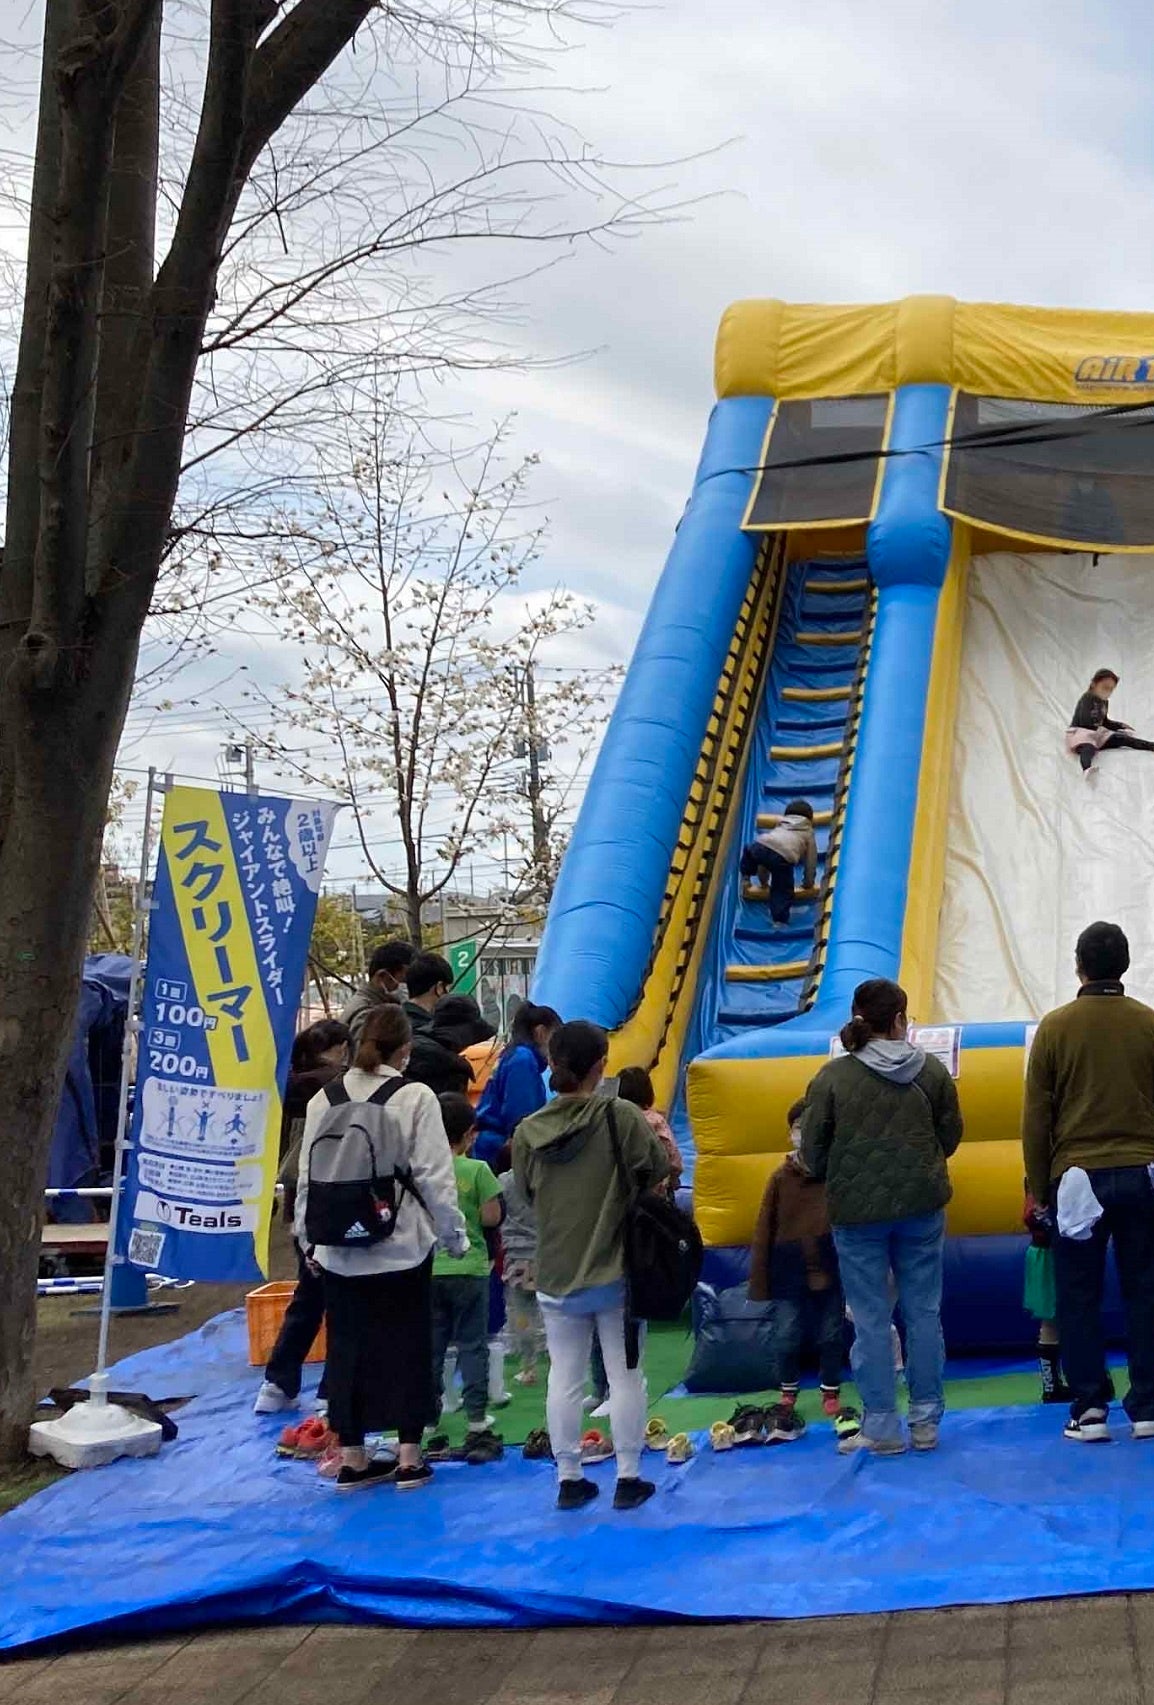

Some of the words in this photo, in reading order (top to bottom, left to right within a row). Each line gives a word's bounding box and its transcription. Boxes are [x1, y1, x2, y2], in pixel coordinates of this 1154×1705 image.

[232, 810, 284, 1006] ジャイアントスライダー
[173, 820, 253, 1063] スクリーマー
[457, 950, 470, 968] 2
[156, 1002, 217, 1030] 100円
[149, 1050, 208, 1079] 200円
[175, 1207, 242, 1228] Teals
